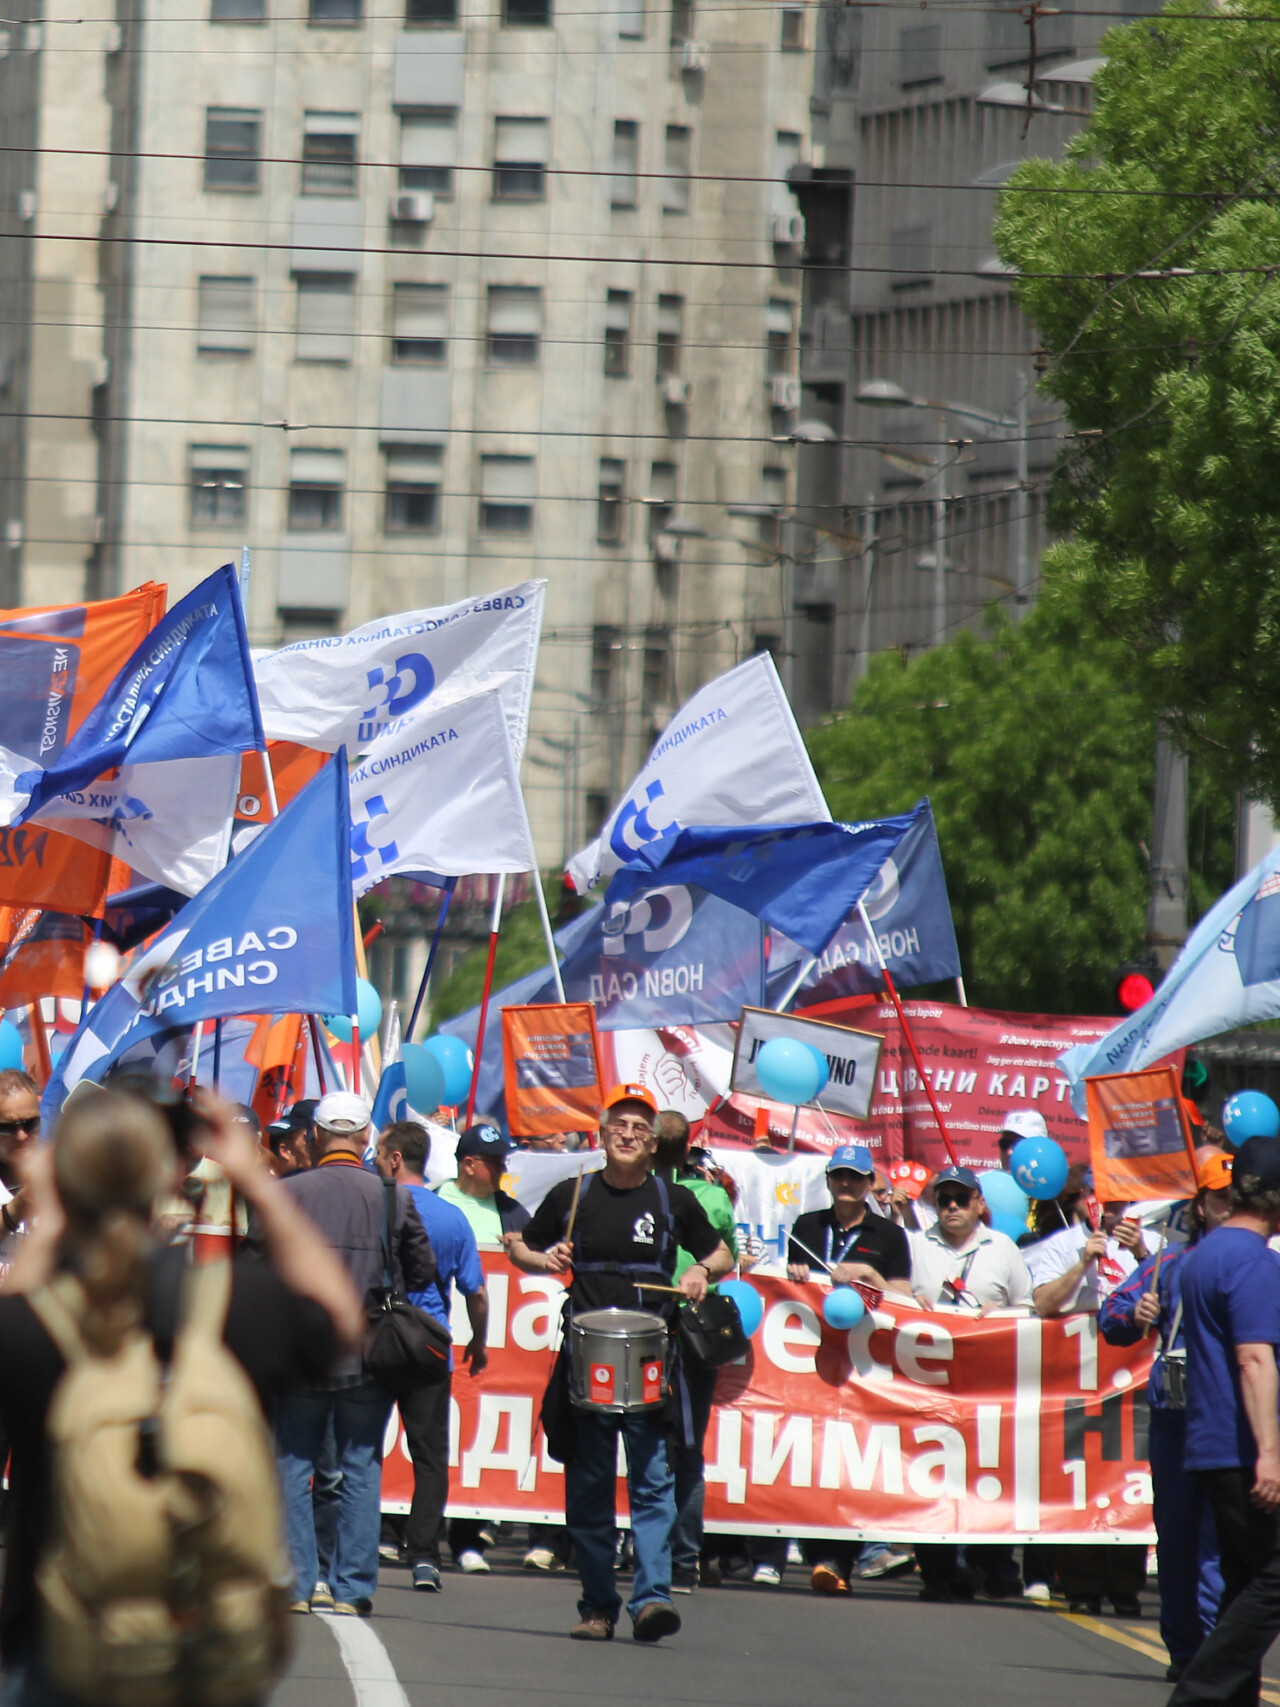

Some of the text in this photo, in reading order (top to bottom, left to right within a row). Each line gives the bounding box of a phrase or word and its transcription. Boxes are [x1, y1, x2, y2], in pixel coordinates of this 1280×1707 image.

[371, 728, 460, 776] СИНДИКАТА
[651, 708, 728, 762] СИНДИКАТА
[849, 1136, 883, 1149] Karte!
